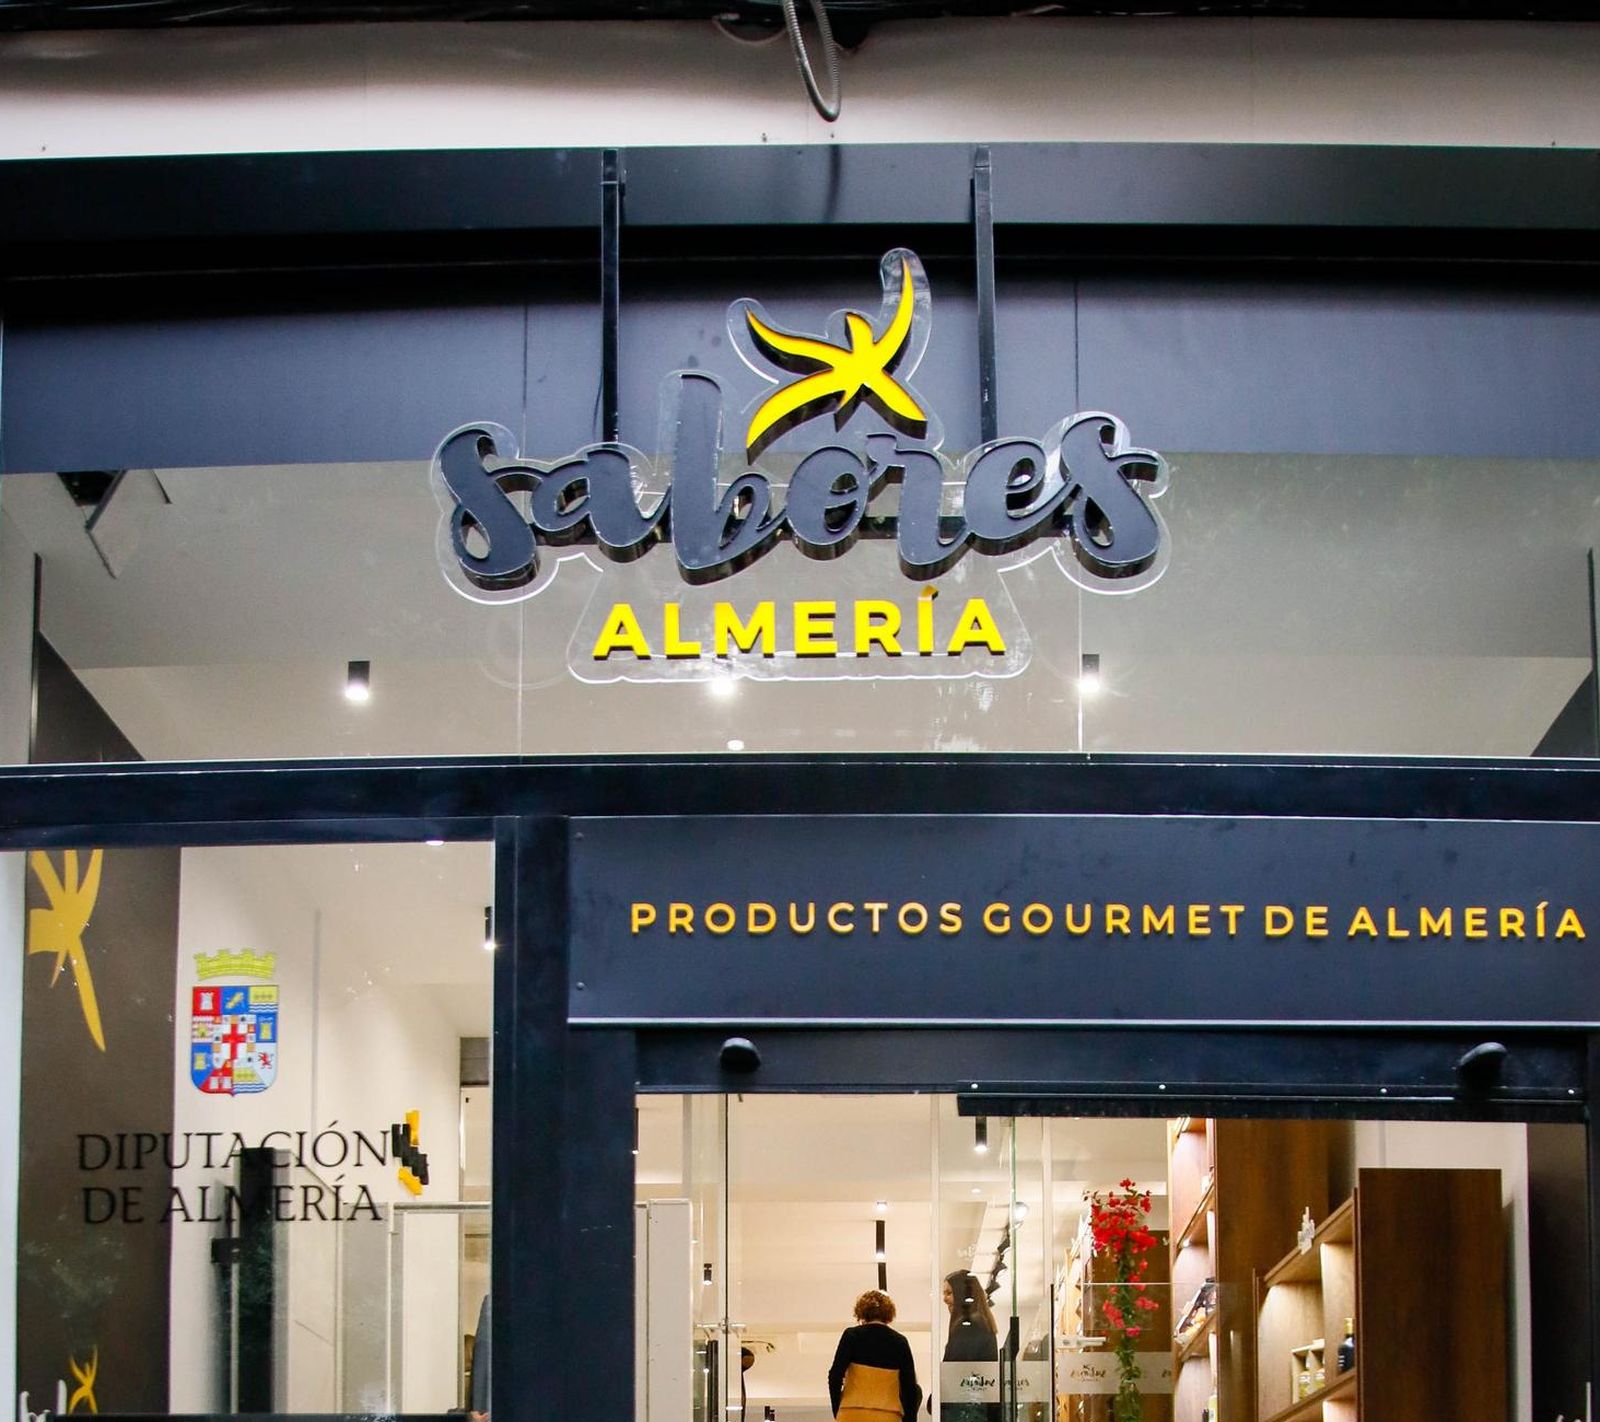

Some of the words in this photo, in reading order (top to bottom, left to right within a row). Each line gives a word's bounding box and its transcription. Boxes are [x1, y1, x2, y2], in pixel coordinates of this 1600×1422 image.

[438, 373, 1163, 590] sabores
[592, 584, 1006, 660] ALMERÍA
[630, 901, 963, 935] PRODUCTOS
[982, 902, 1246, 937] GOURMET
[1264, 905, 1329, 937] DE
[1347, 901, 1587, 940] ALMERÍA
[82, 1186, 144, 1224] DE
